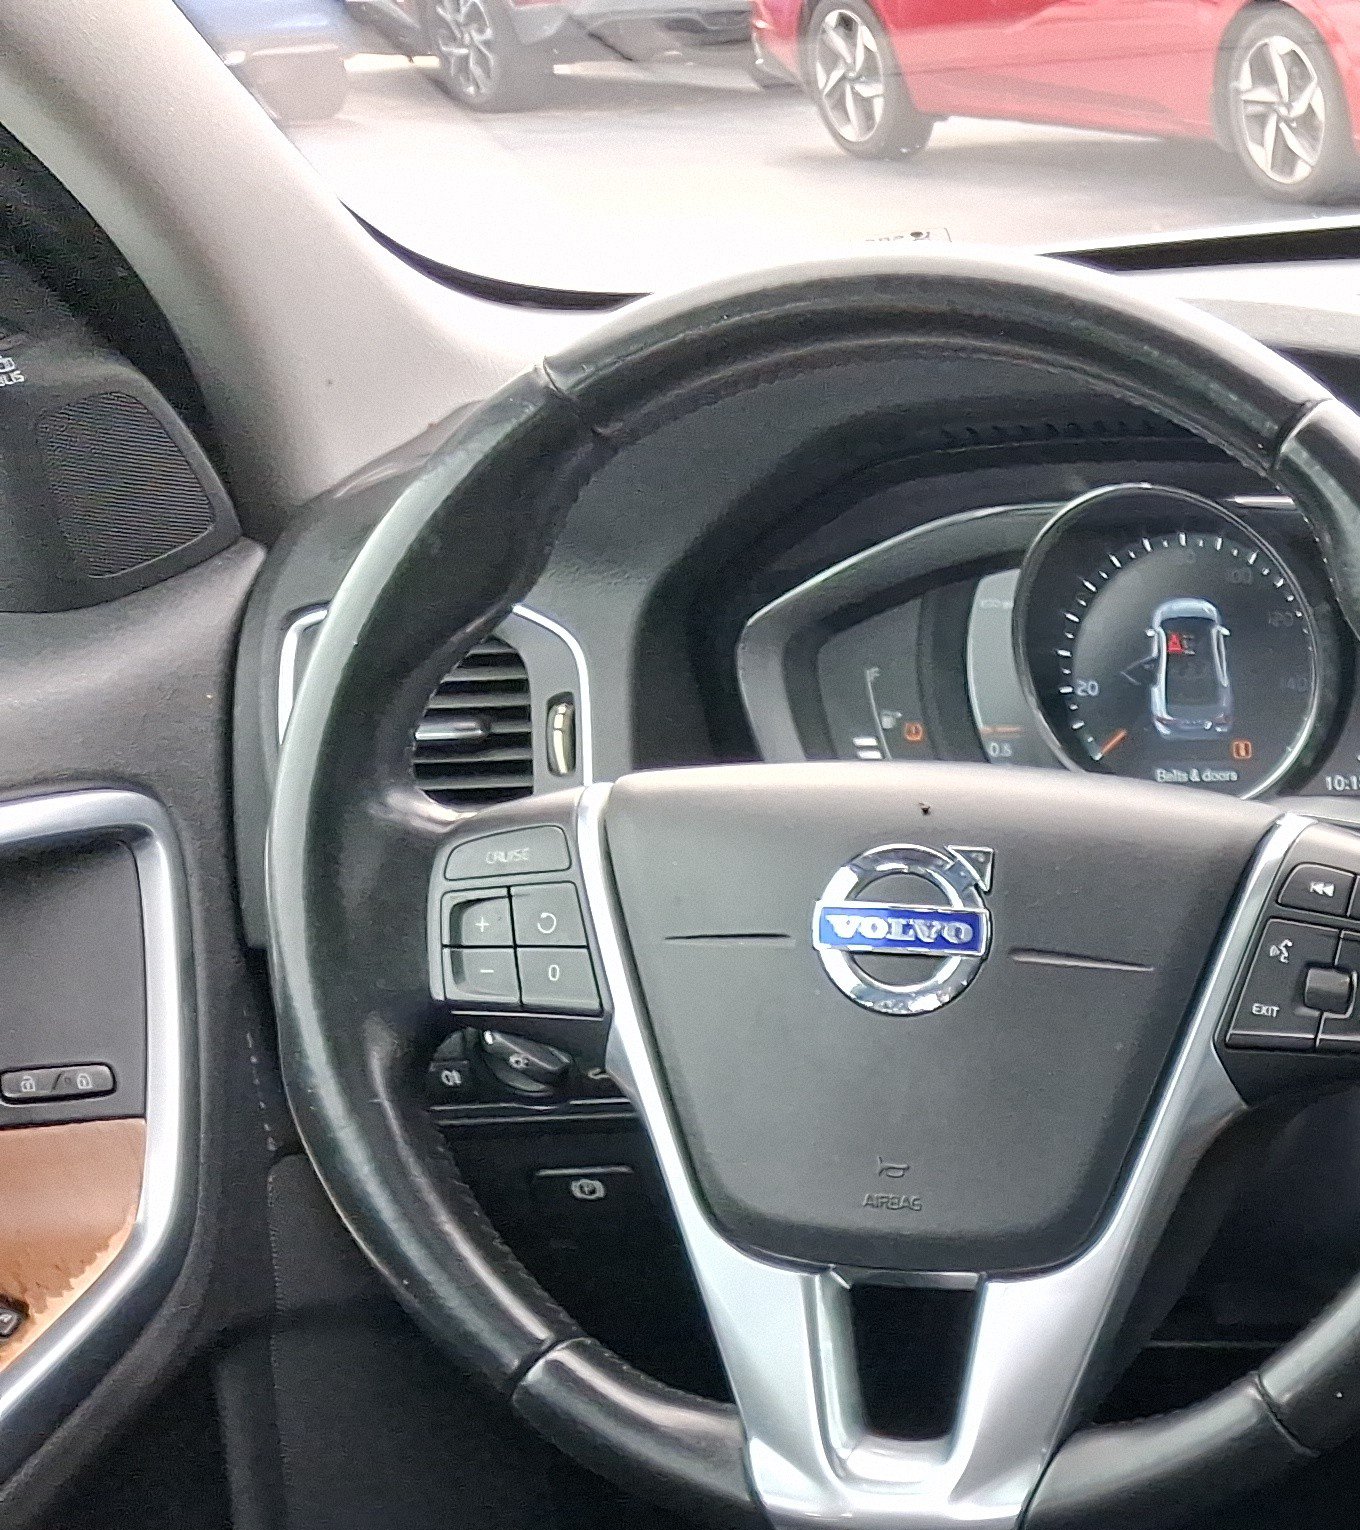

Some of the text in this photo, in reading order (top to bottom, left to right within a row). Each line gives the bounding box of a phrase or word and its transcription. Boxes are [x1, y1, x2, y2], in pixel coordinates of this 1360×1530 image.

[1075, 680, 1099, 697] 20
[1202, 769, 1238, 782] doors
[825, 914, 974, 945] VOLVO
[1251, 1002, 1280, 1018] EXIT
